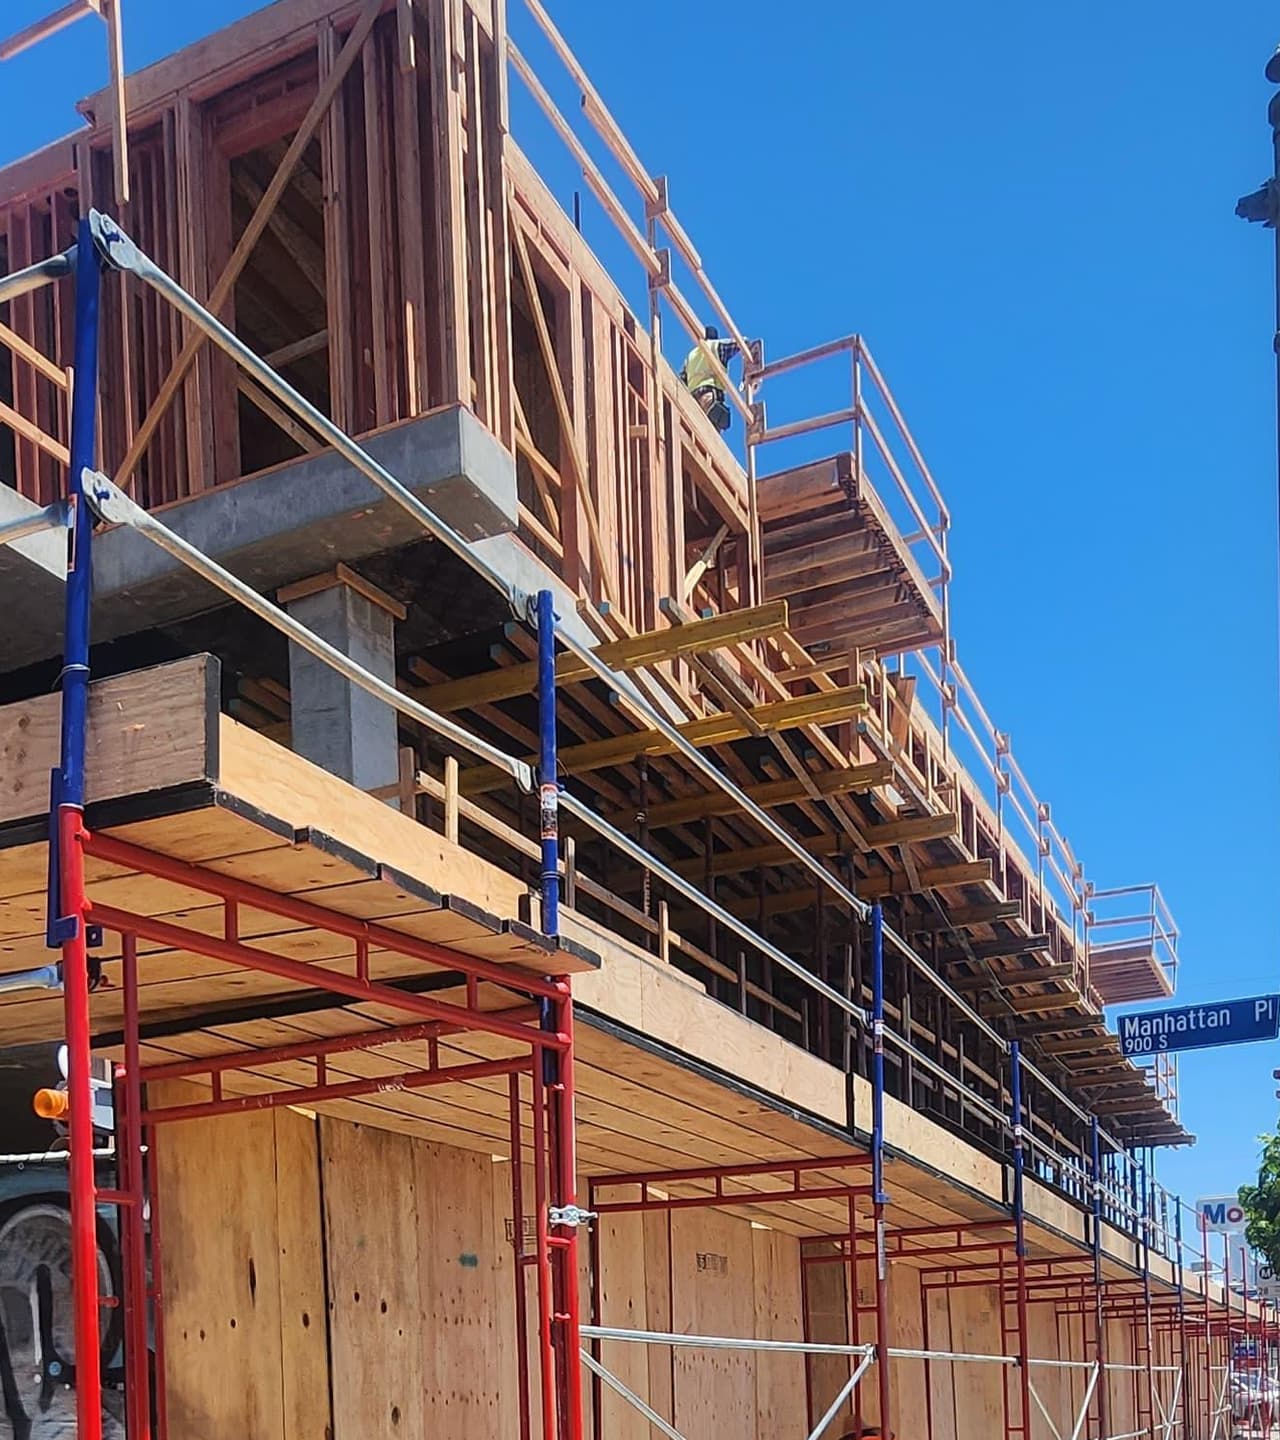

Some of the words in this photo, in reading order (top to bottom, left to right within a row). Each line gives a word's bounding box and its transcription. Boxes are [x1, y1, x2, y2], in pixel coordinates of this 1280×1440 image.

[1124, 1008, 1231, 1038] Manhattan
[1254, 1000, 1273, 1022] Pl
[1125, 1037, 1153, 1053] 900
[1158, 1035, 1168, 1048] S
